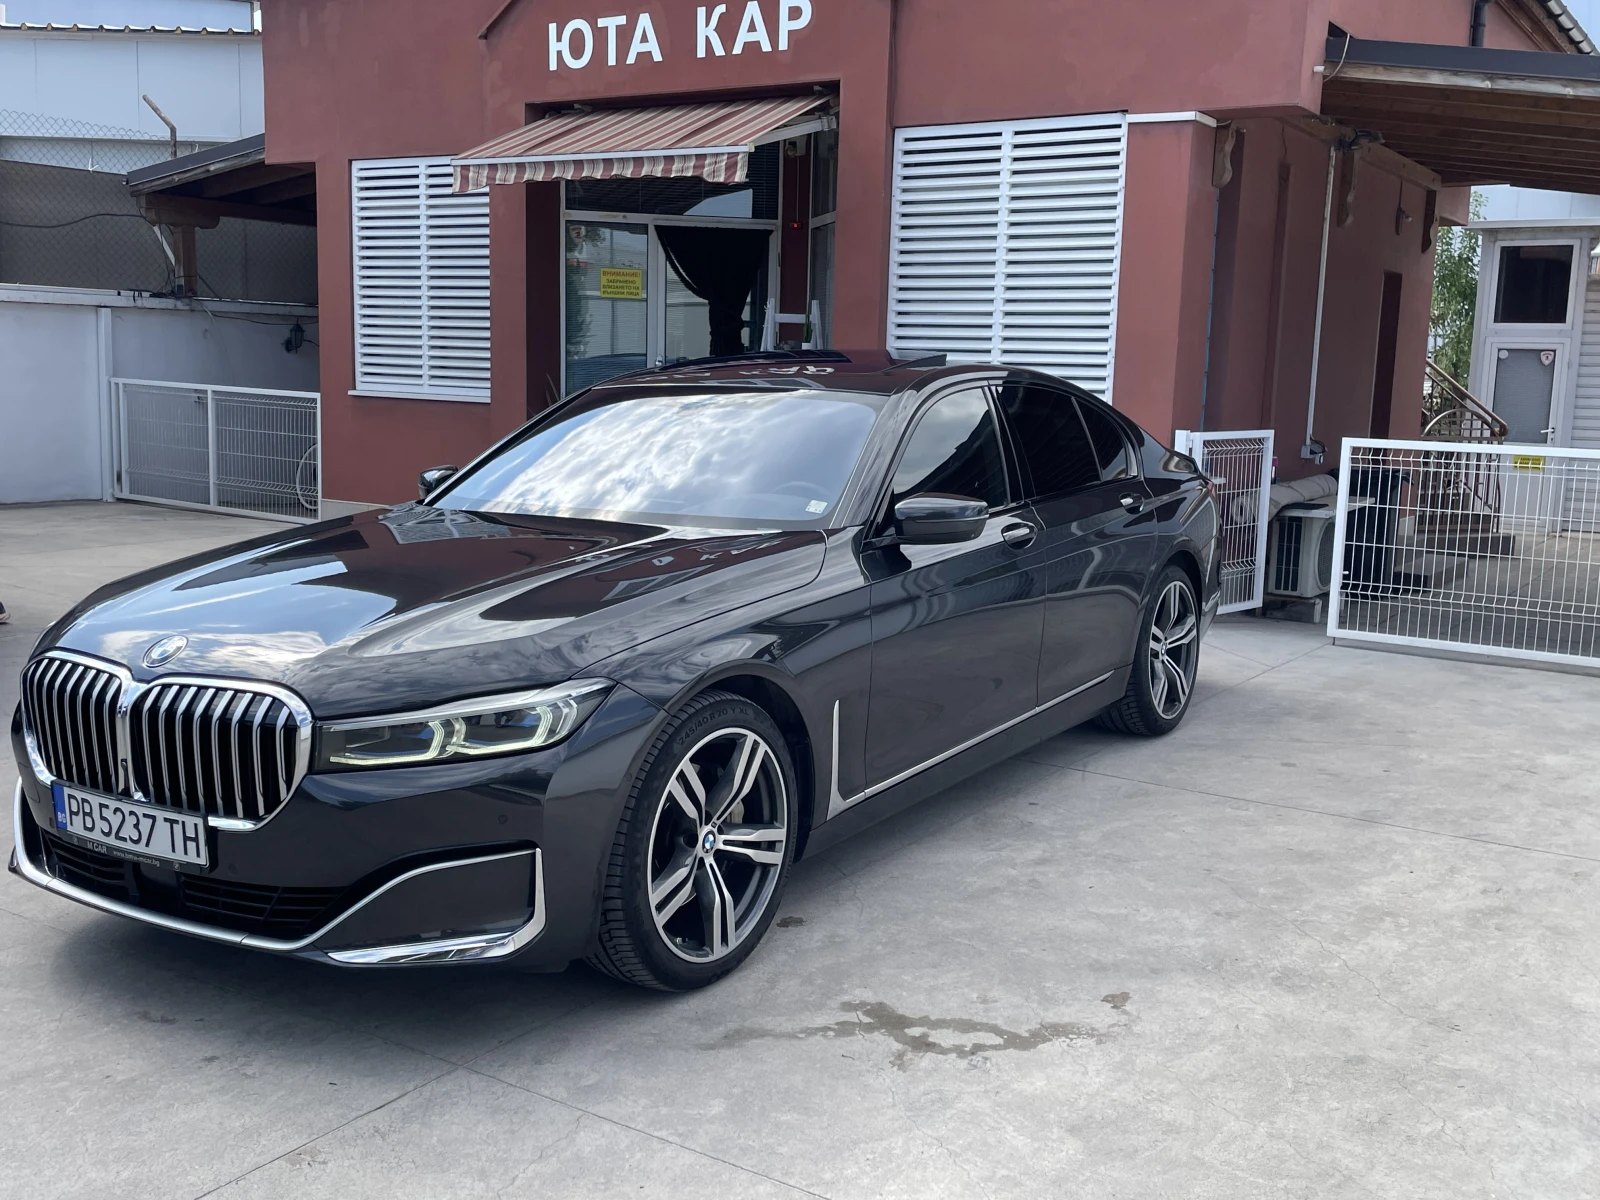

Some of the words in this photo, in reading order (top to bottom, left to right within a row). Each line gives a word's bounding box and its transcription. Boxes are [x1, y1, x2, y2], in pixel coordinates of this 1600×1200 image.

[548, 12, 663, 71] ЮТА
[696, 0, 813, 58] КАР
[602, 270, 641, 278] ВНИМАНИЕ!
[679, 716, 709, 745] 245/40
[717, 708, 728, 718] 20
[57, 811, 67, 824] BG
[67, 793, 96, 833] PB
[98, 802, 157, 848] 5237
[163, 817, 201, 858] TH
